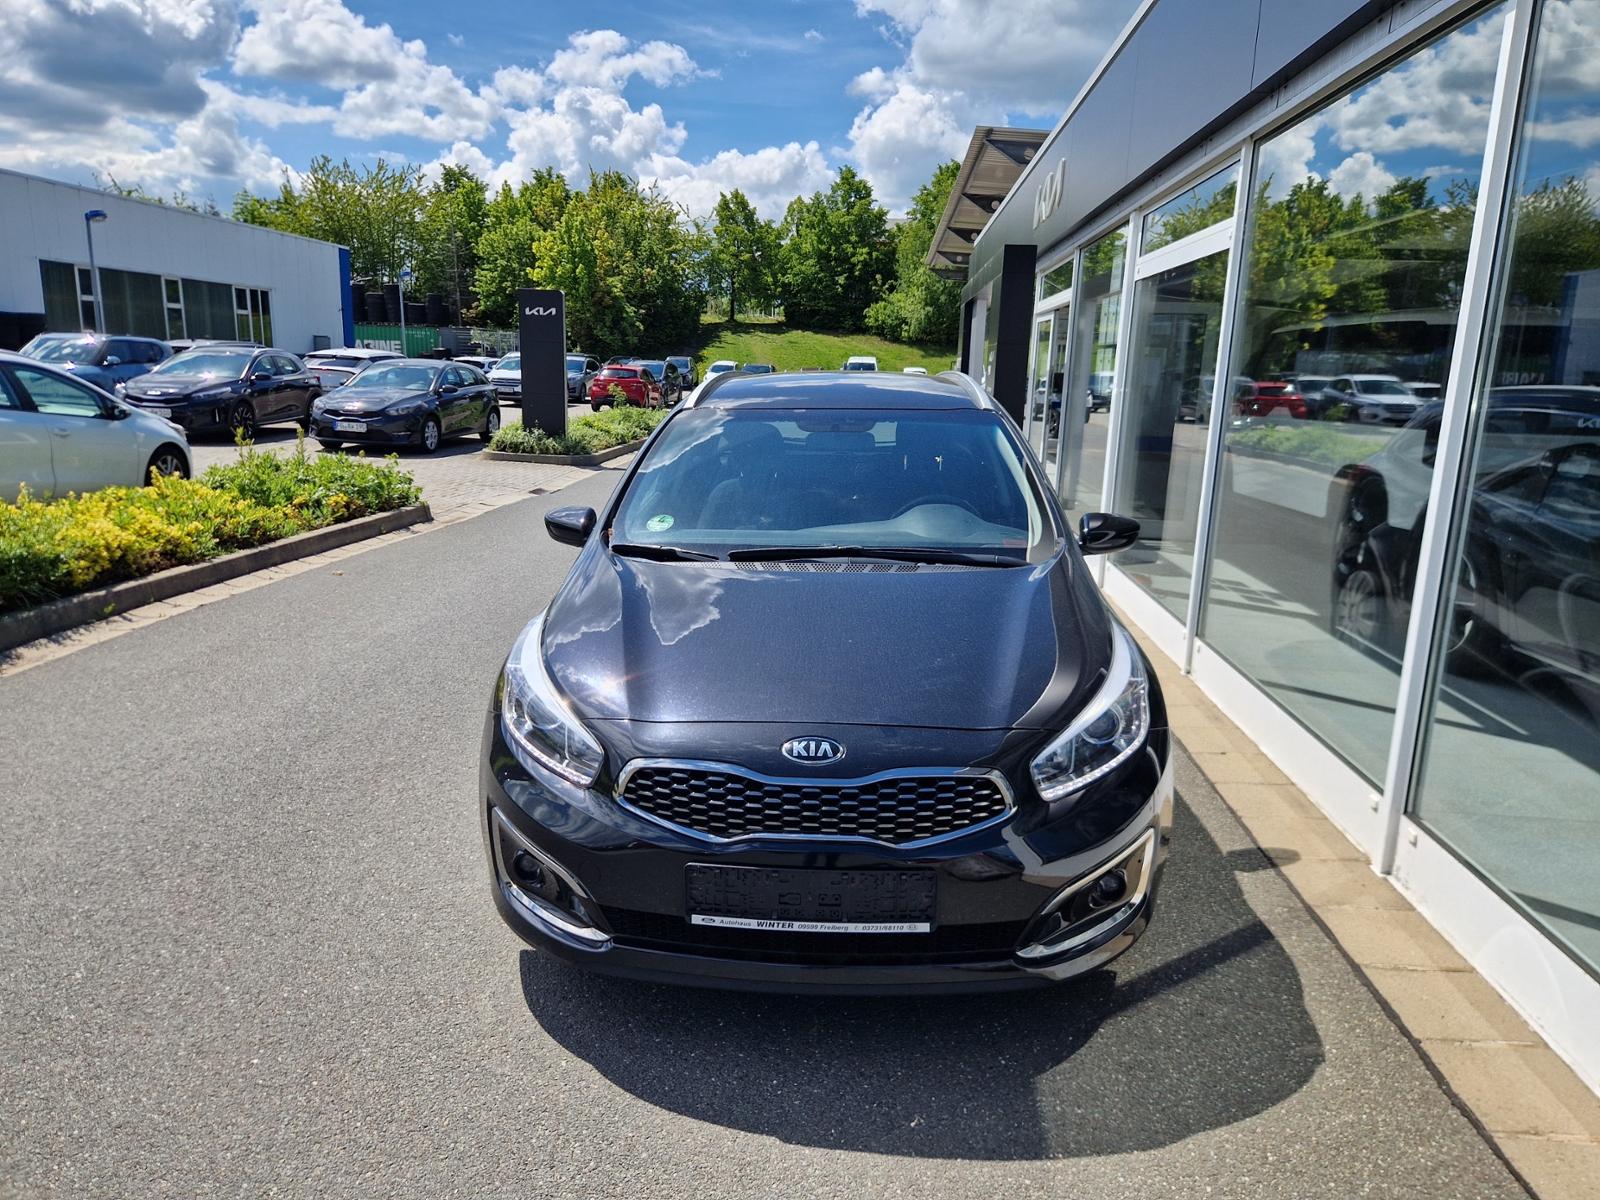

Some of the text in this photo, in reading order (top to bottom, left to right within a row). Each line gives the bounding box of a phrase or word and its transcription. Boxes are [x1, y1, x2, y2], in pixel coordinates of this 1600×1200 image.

[792, 740, 834, 757] KIA
[719, 919, 752, 927] Autohaus
[756, 920, 794, 929] WINTER
[819, 923, 849, 931] Freiberg
